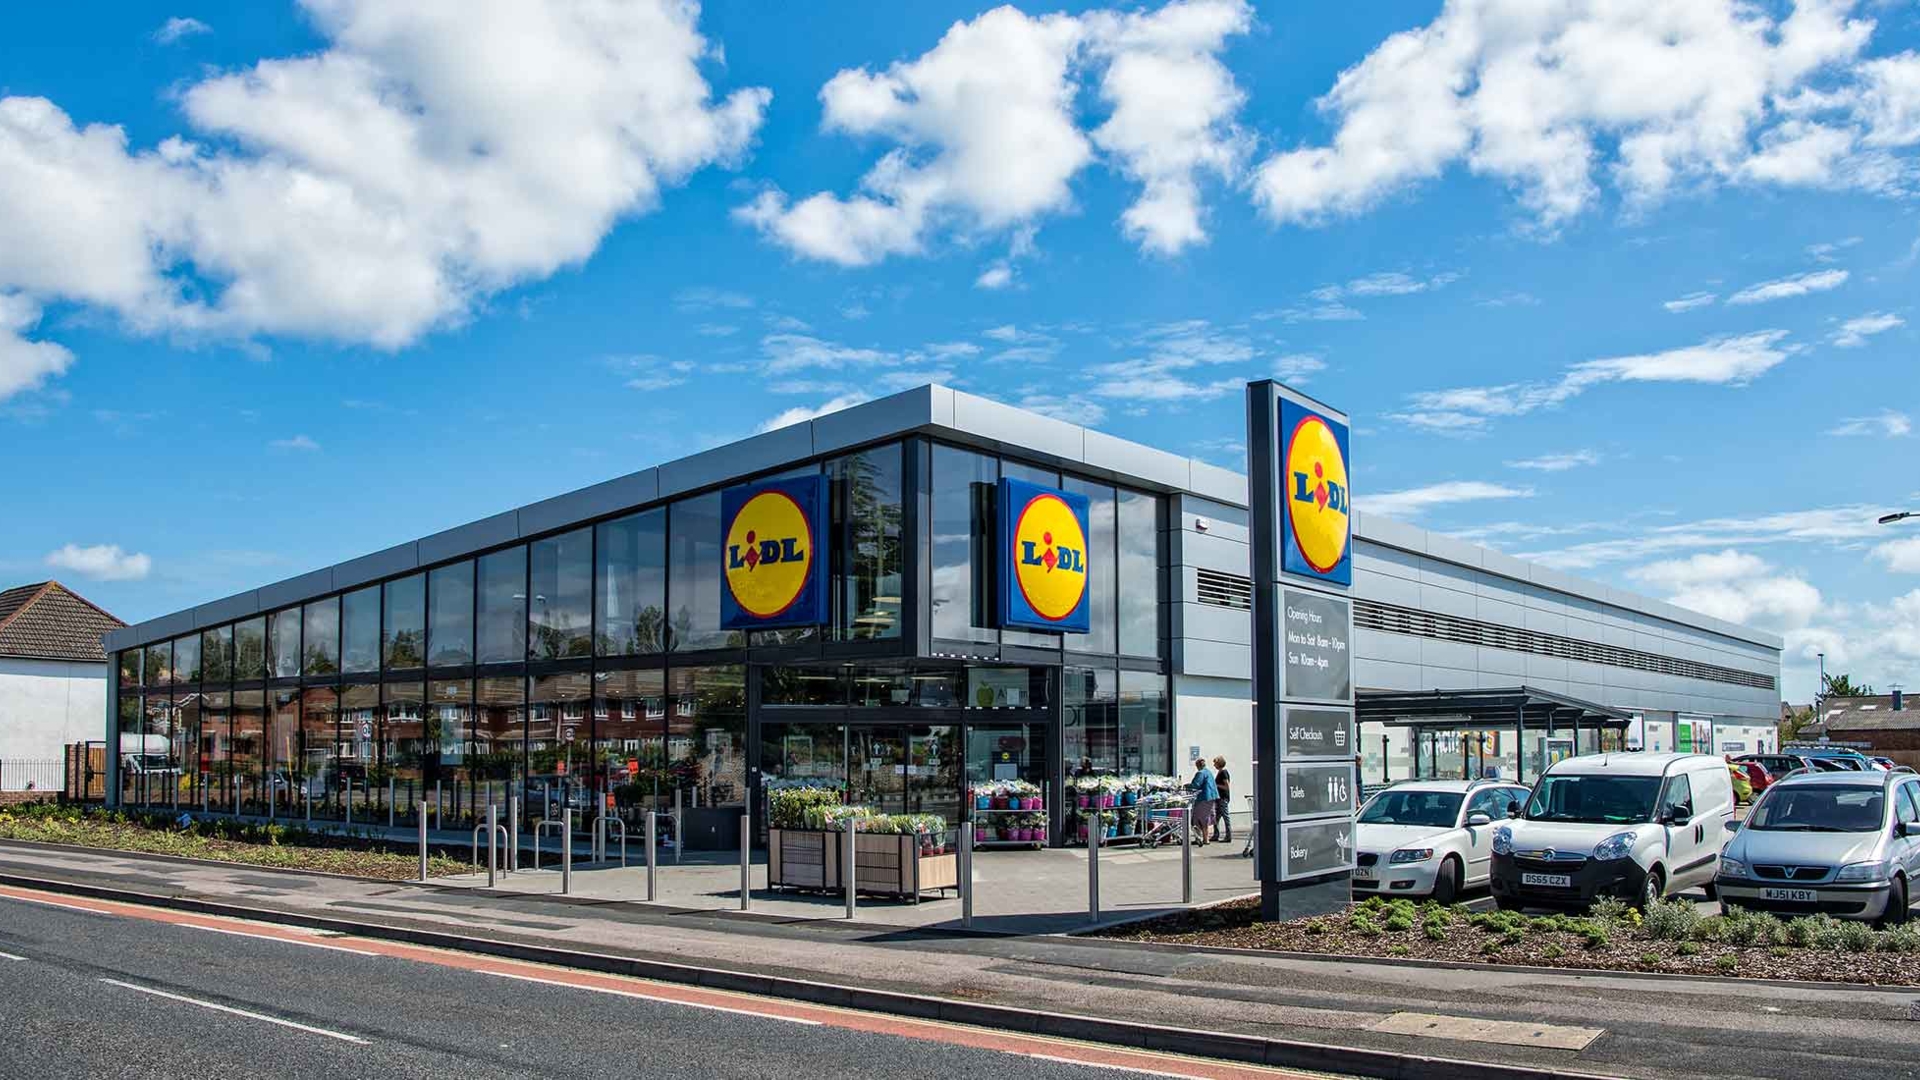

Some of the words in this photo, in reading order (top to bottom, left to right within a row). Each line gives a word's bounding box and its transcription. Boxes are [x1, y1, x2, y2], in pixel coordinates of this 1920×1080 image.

[1293, 461, 1348, 516] LIDL
[729, 530, 804, 572] LIDL
[1021, 531, 1084, 574] LIDL
[1287, 605, 1308, 625] Opening
[1309, 609, 1322, 624] Hours
[1288, 630, 1300, 644] Mon
[1300, 633, 1307, 645] to
[1307, 632, 1315, 646] Sat
[1288, 651, 1299, 665] Sun
[1289, 726, 1300, 740] Self
[1290, 785, 1305, 799] Toilets
[1290, 845, 1309, 861] Bakery
[1549, 876, 1566, 885] CZX
[1791, 890, 1812, 900] KBY
